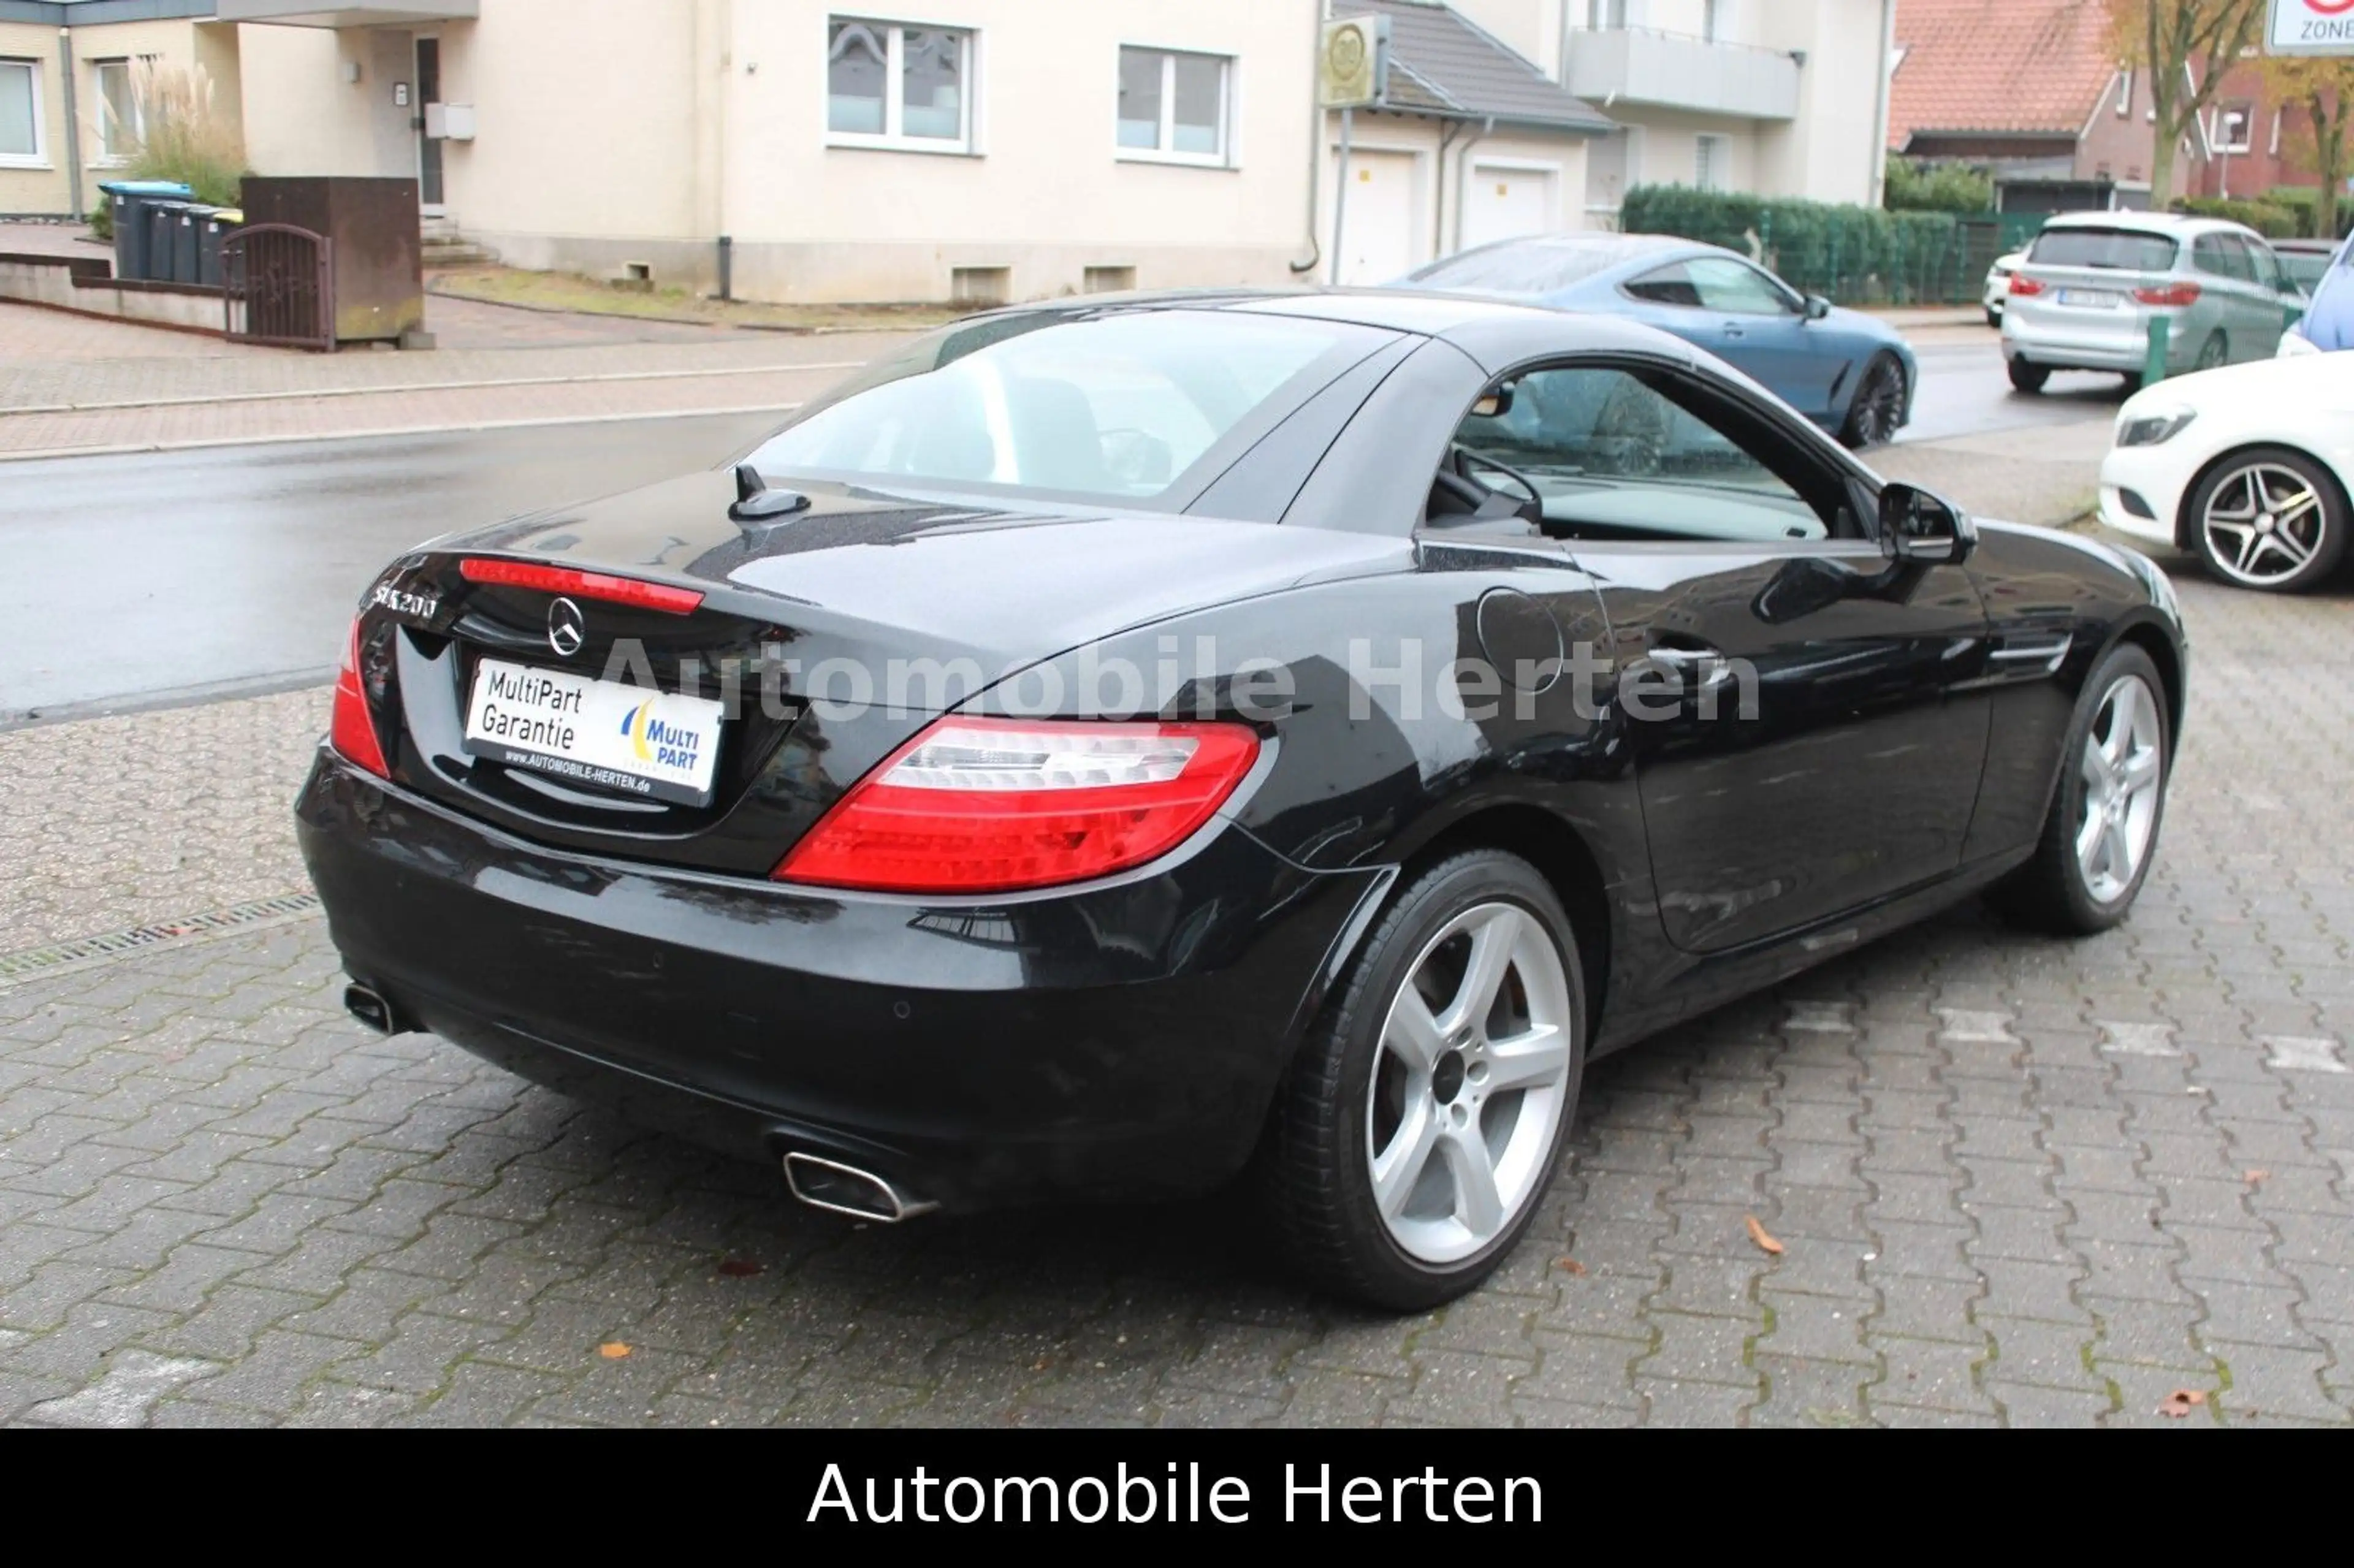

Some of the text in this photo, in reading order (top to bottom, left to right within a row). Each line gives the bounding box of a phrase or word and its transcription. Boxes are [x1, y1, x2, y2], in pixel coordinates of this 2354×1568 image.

[2301, 20, 2354, 40] ZONE
[489, 669, 582, 714] MultiPart
[482, 703, 574, 749] Garantie
[646, 719, 699, 750] MULTI
[505, 750, 651, 792] www.AUTOMOBILE-HERTEN.de
[657, 747, 698, 771] PART
